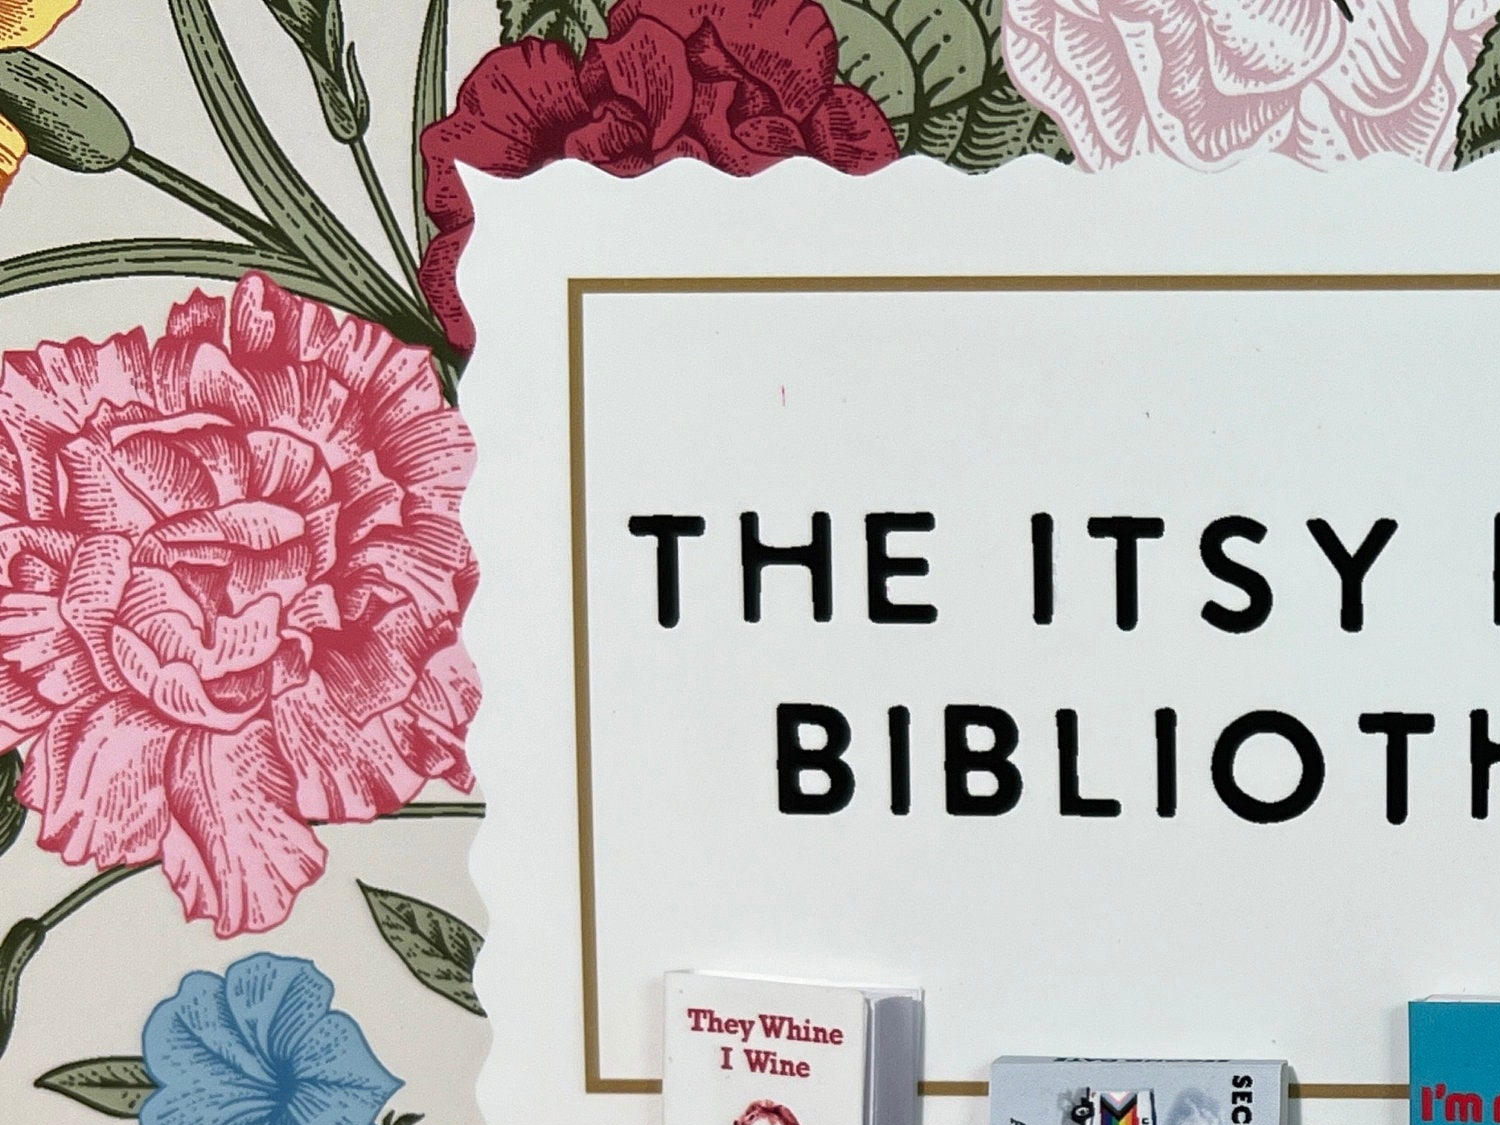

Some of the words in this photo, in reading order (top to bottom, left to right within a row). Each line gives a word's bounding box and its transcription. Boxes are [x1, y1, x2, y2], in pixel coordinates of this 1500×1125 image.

[629, 511, 937, 628] THE
[1031, 511, 1397, 634] ITSY
[688, 1008, 755, 1042] They
[758, 1014, 844, 1046] Whine
[720, 1047, 734, 1072] I
[743, 1049, 811, 1079] Wine
[1420, 1084, 1481, 1125] I'm
